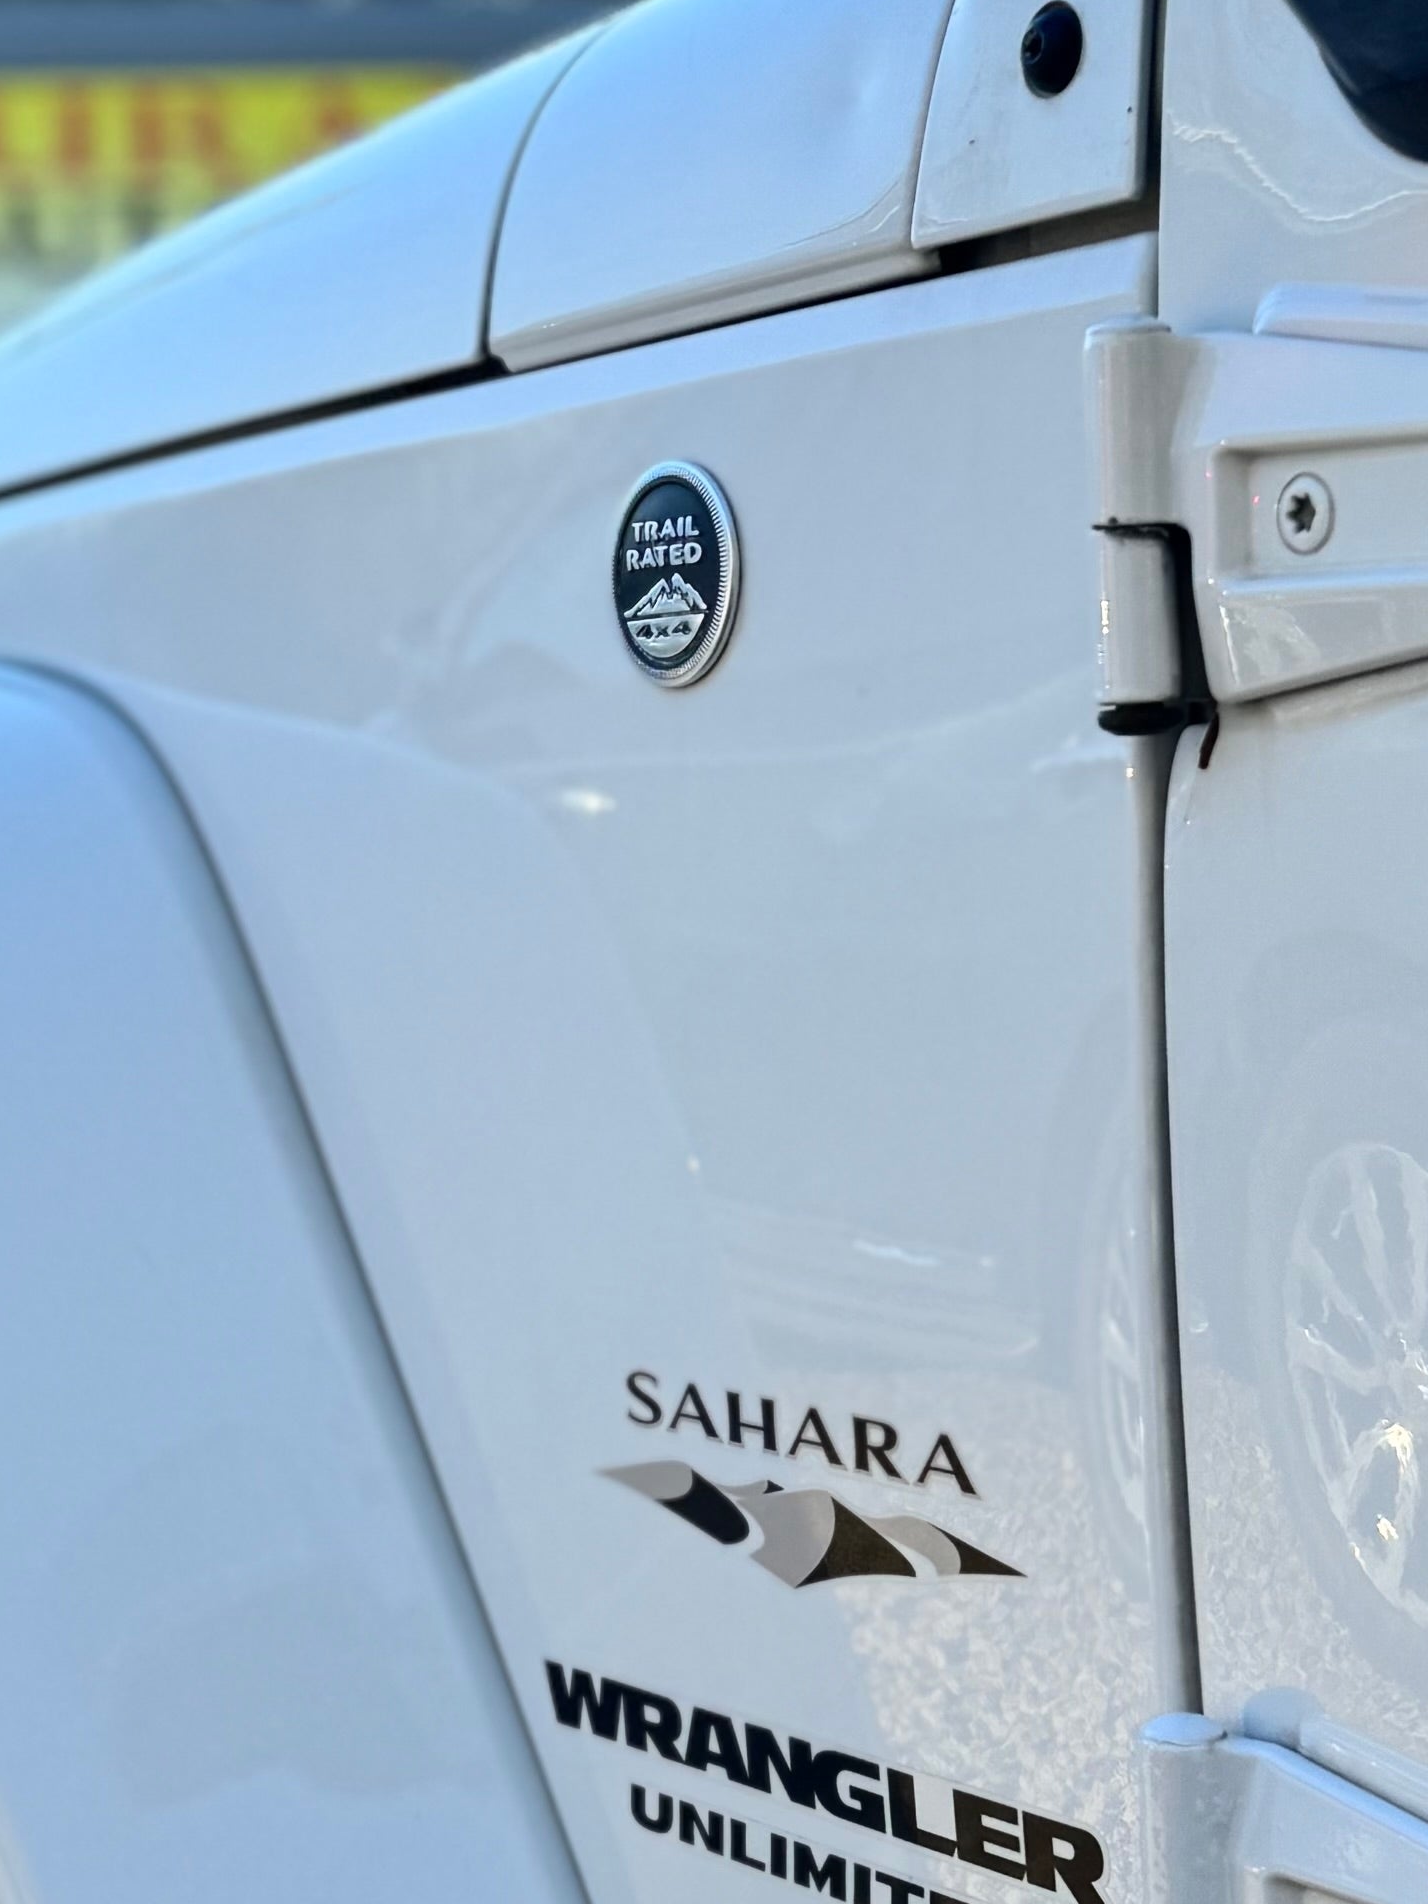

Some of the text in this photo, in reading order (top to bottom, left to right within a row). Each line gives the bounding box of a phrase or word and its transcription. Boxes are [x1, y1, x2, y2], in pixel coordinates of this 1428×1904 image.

[632, 515, 700, 542] TRAIL
[626, 542, 703, 571] RATED
[625, 1370, 980, 1498] SAHARA
